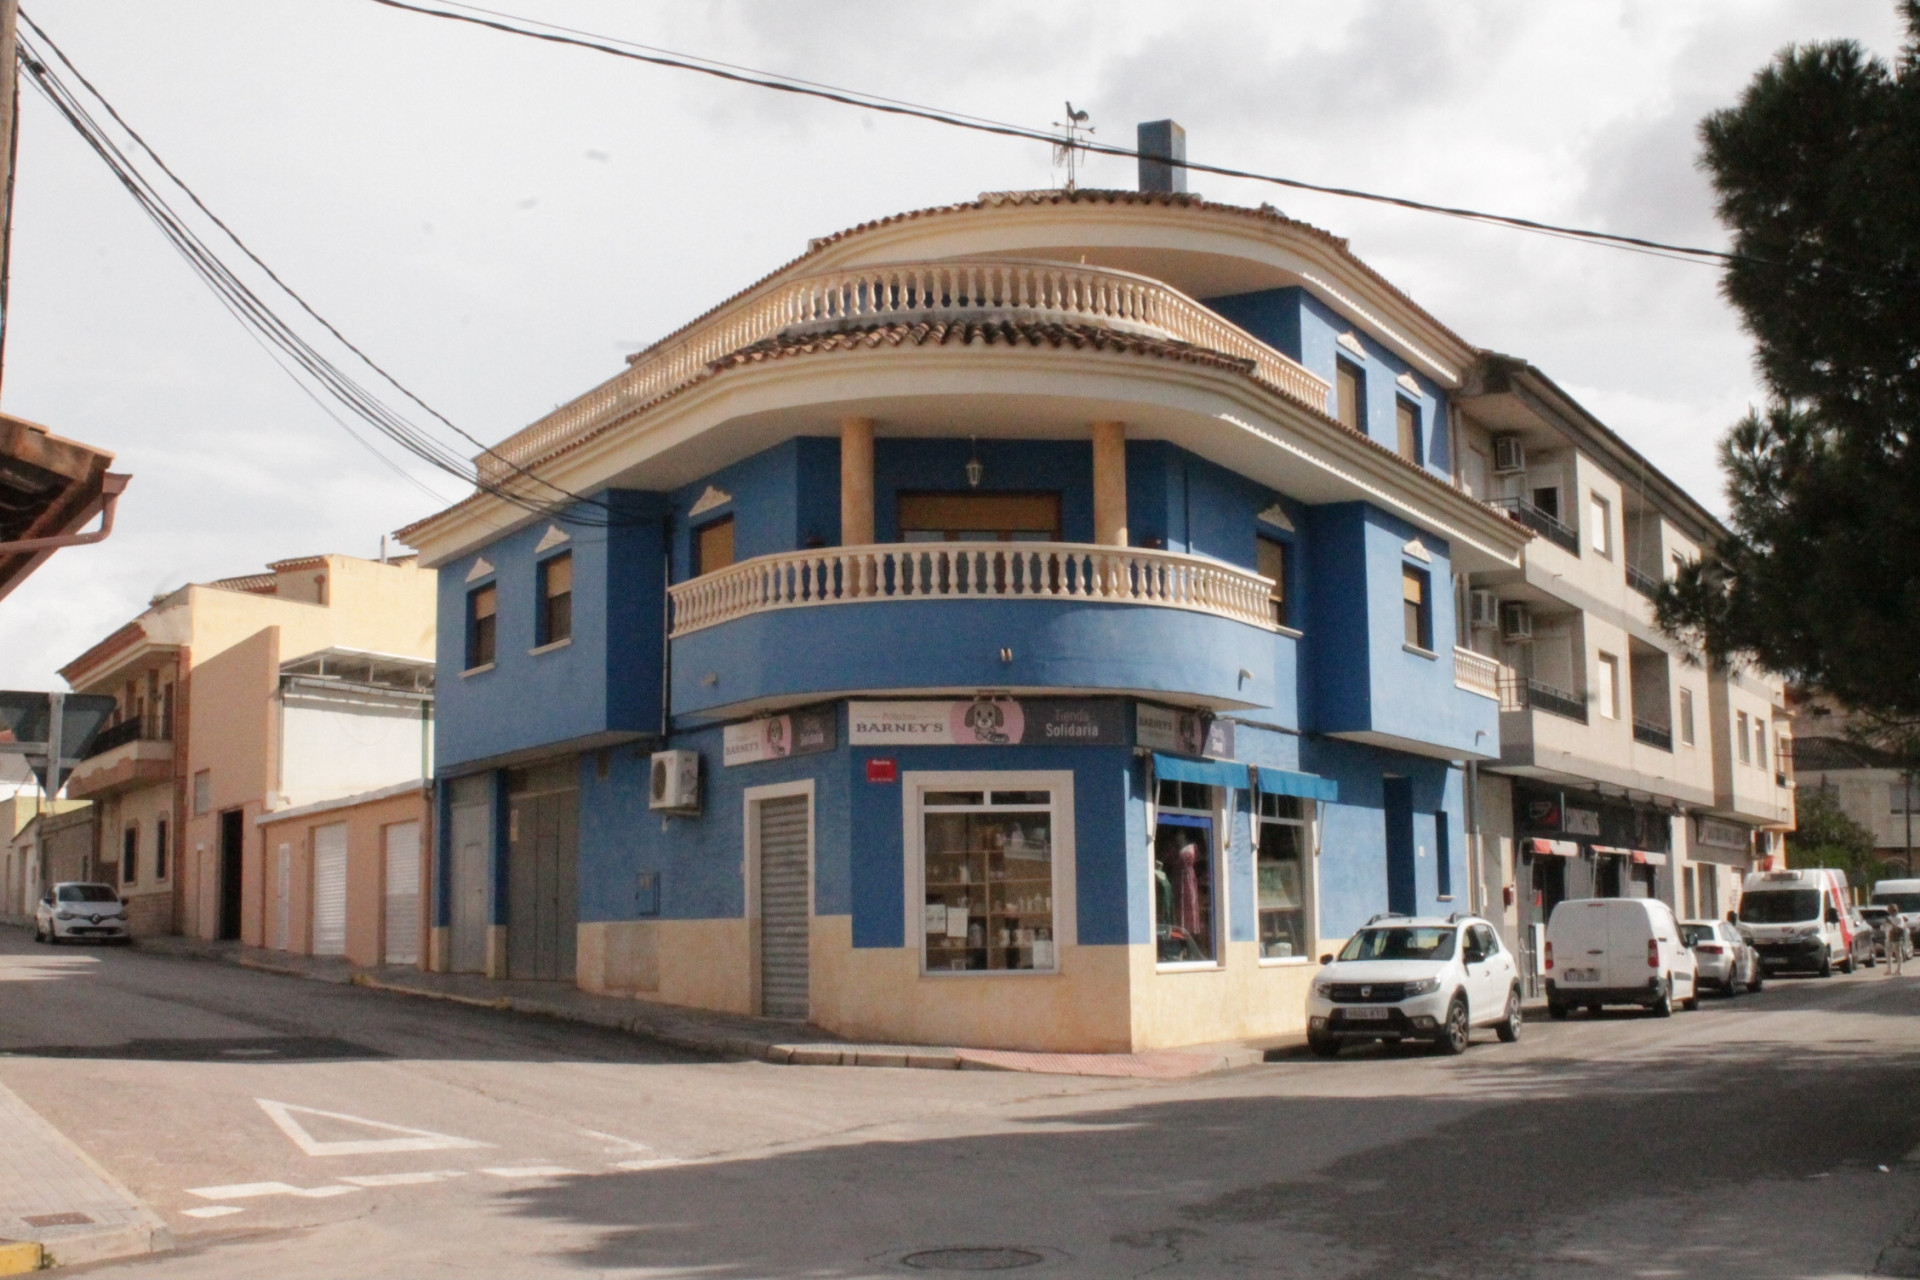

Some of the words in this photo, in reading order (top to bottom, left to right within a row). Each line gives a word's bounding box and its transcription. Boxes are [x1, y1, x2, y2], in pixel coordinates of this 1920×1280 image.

[1055, 708, 1089, 722] Tienda
[856, 722, 943, 733] BARNEY'S
[1046, 722, 1099, 737] Solidaria
